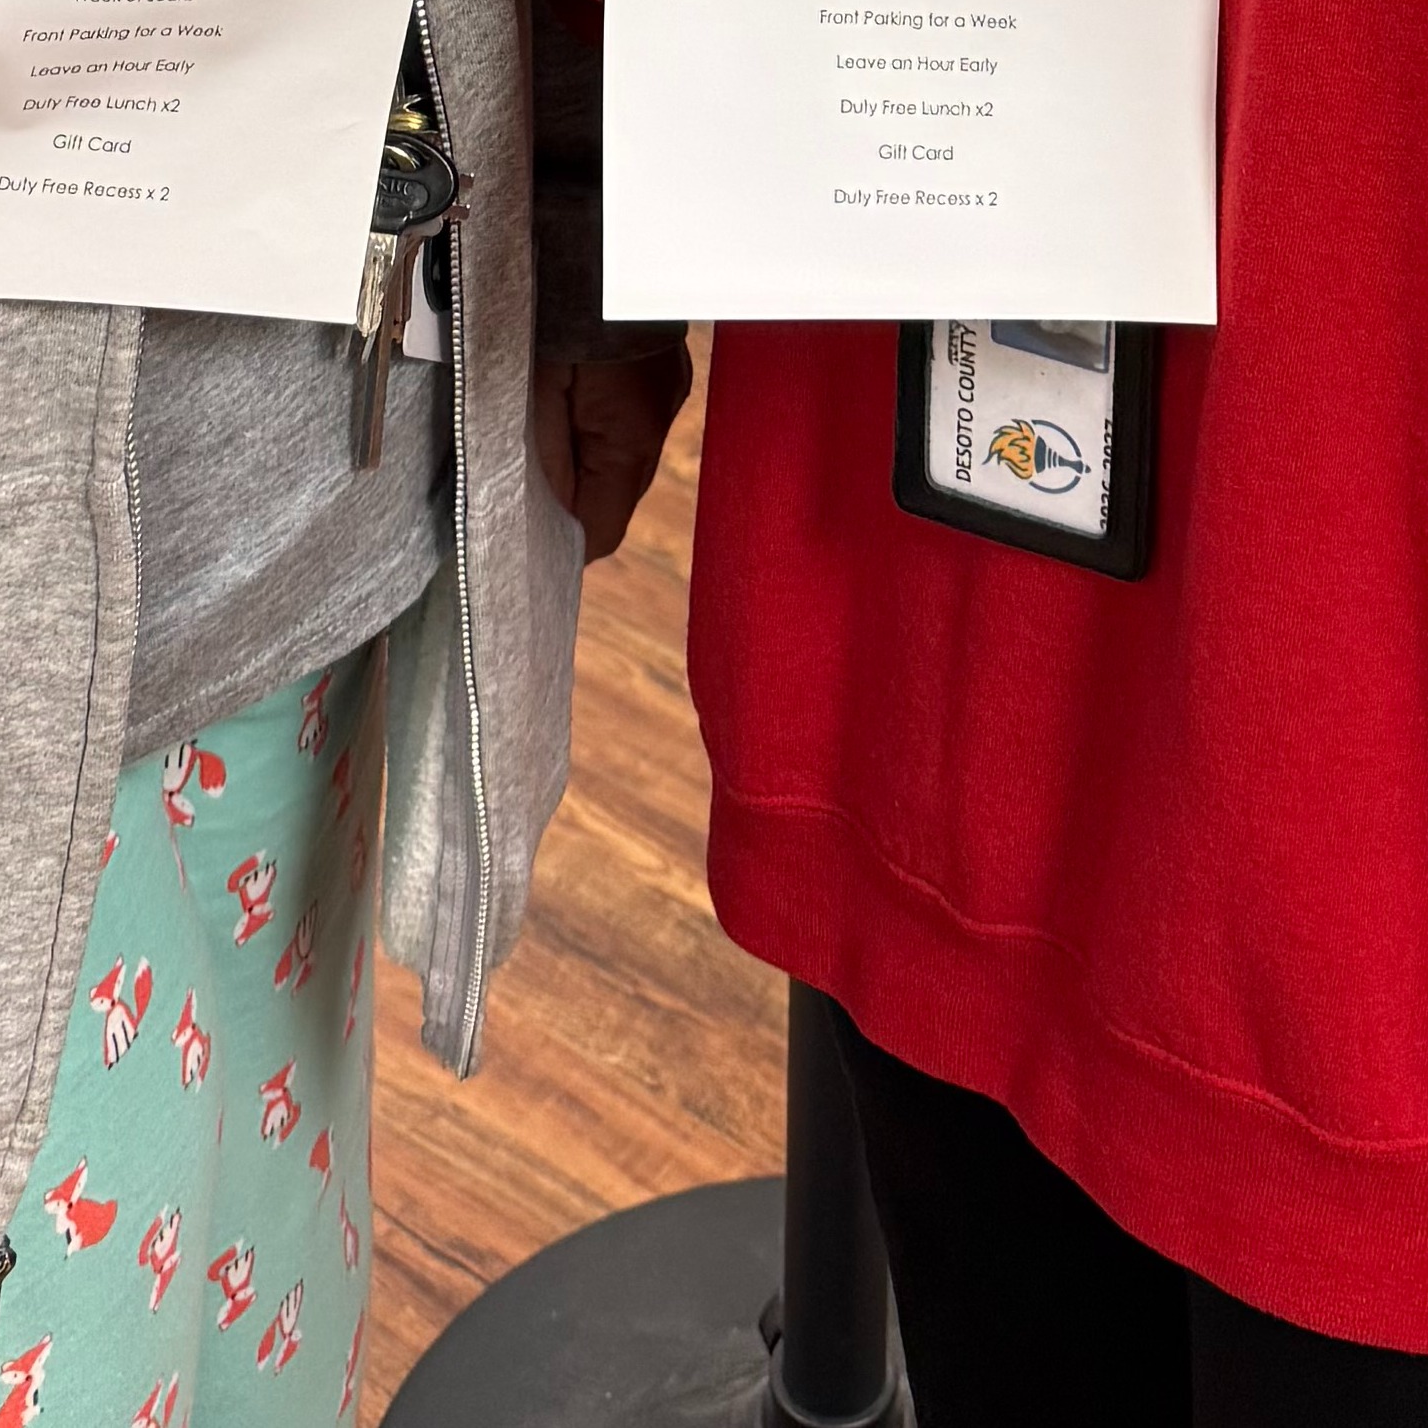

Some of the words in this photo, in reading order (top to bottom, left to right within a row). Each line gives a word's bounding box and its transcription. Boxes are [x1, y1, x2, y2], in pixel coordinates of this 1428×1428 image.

[820, 9, 859, 26] Front
[864, 11, 923, 30] Parking
[928, 11, 949, 28] for
[954, 16, 966, 28] a
[970, 14, 1017, 30] Week
[22, 28, 65, 43] Front
[69, 26, 130, 42] Parking
[134, 25, 157, 38] for
[160, 27, 172, 37] a
[177, 24, 224, 38] Week
[30, 62, 81, 77] Leave
[86, 62, 108, 74] an
[112, 60, 152, 73] Hour
[155, 59, 195, 75] Early
[836, 55, 887, 70] Leave
[891, 58, 913, 71] an
[917, 56, 955, 72] Hour
[959, 57, 998, 75] Early
[22, 97, 62, 112] Duty
[65, 96, 101, 109] Free
[106, 96, 157, 112] Lunch
[160, 98, 181, 113] x2
[840, 98, 878, 117] Duty
[882, 100, 917, 115] Free
[922, 100, 971, 117] Lunch
[975, 102, 994, 118] x2
[52, 133, 83, 151] Gift
[87, 135, 132, 154] Card
[878, 143, 907, 160] Gift
[912, 144, 954, 161] Card
[41, 178, 78, 195] Free
[83, 181, 142, 200] Recess
[159, 186, 171, 202] 2
[833, 189, 871, 207] Duty
[875, 189, 911, 206] Free
[915, 190, 971, 207] Recess
[987, 191, 999, 207] 2
[957, 324, 977, 404] COUNTY
[955, 406, 974, 483] DESOTO
